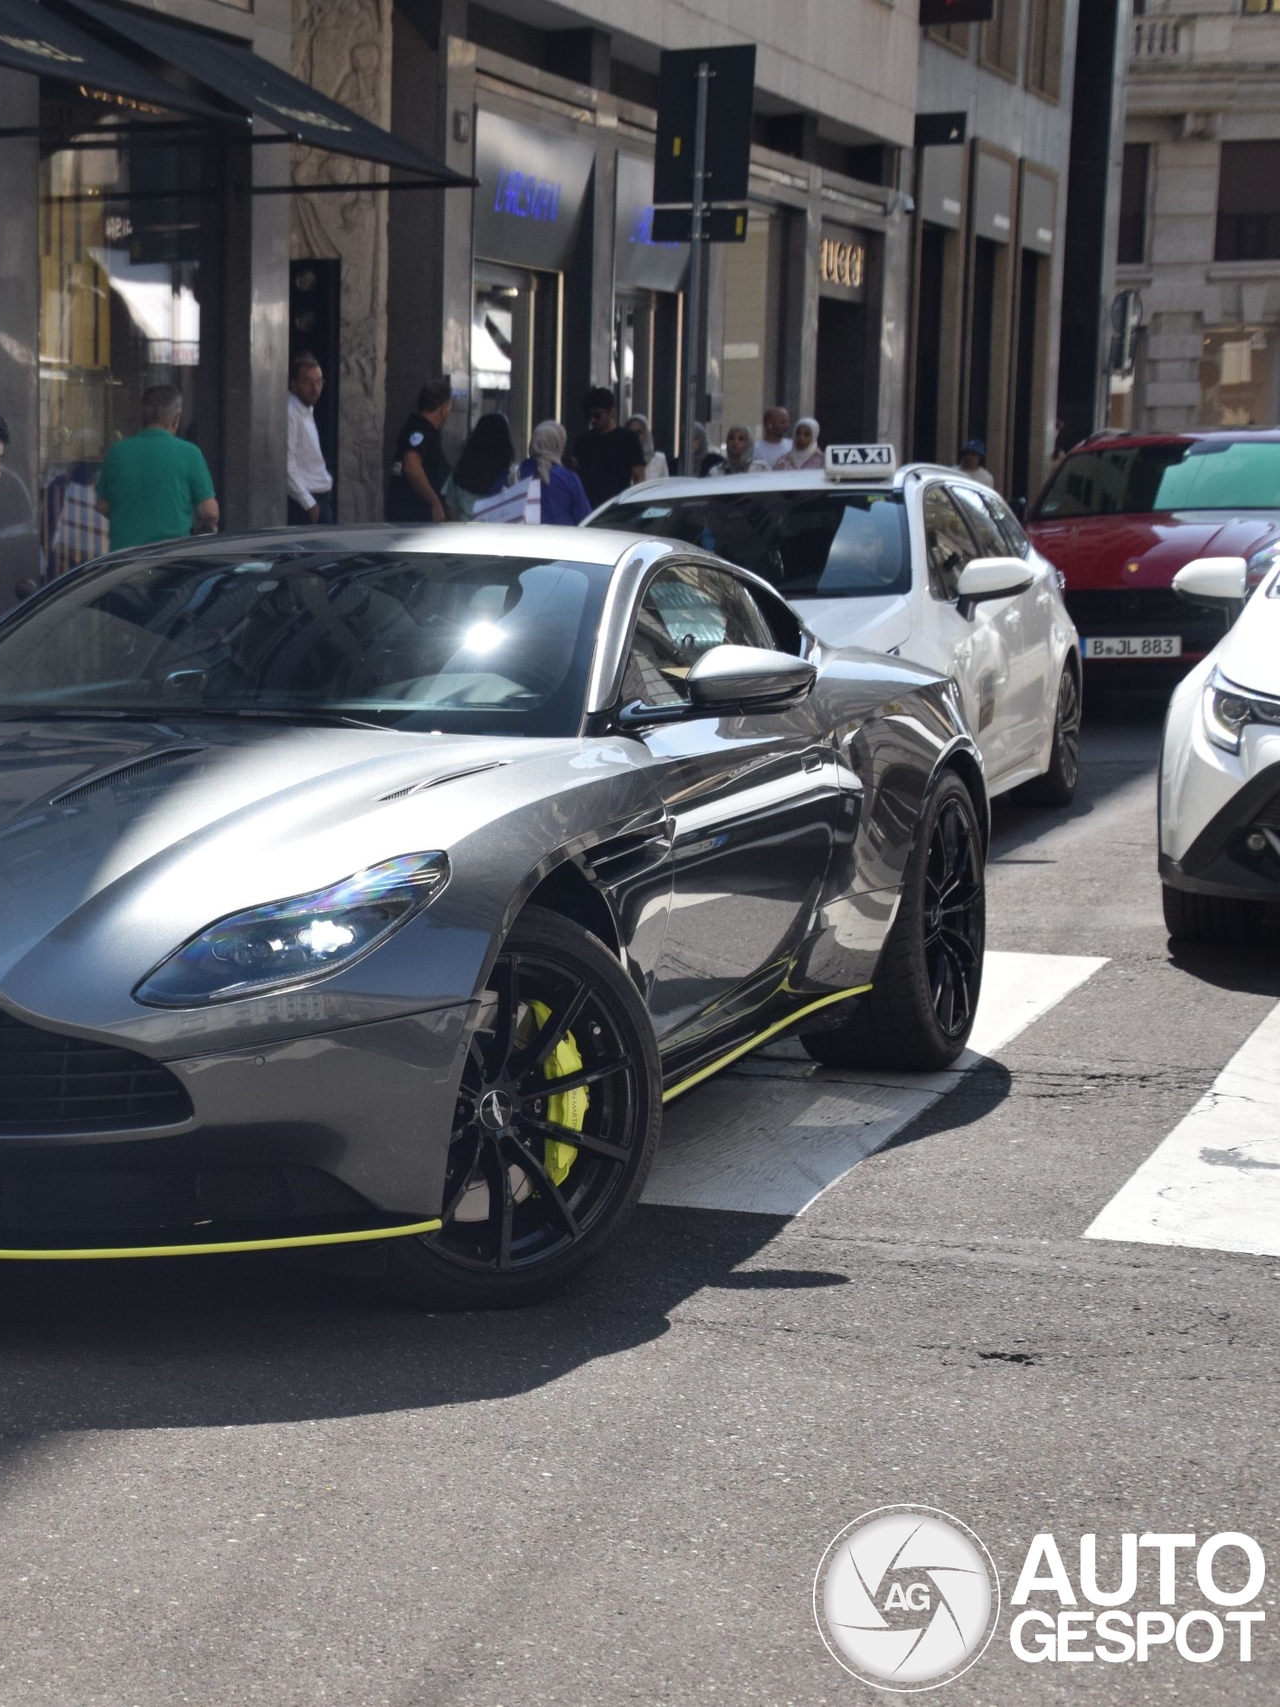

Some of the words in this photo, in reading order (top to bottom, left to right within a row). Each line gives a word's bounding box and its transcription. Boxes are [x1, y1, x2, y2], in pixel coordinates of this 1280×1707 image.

[832, 448, 889, 464] TAXI
[1093, 640, 1104, 655] B
[1115, 640, 1137, 655] JL
[1141, 639, 1173, 655] 883
